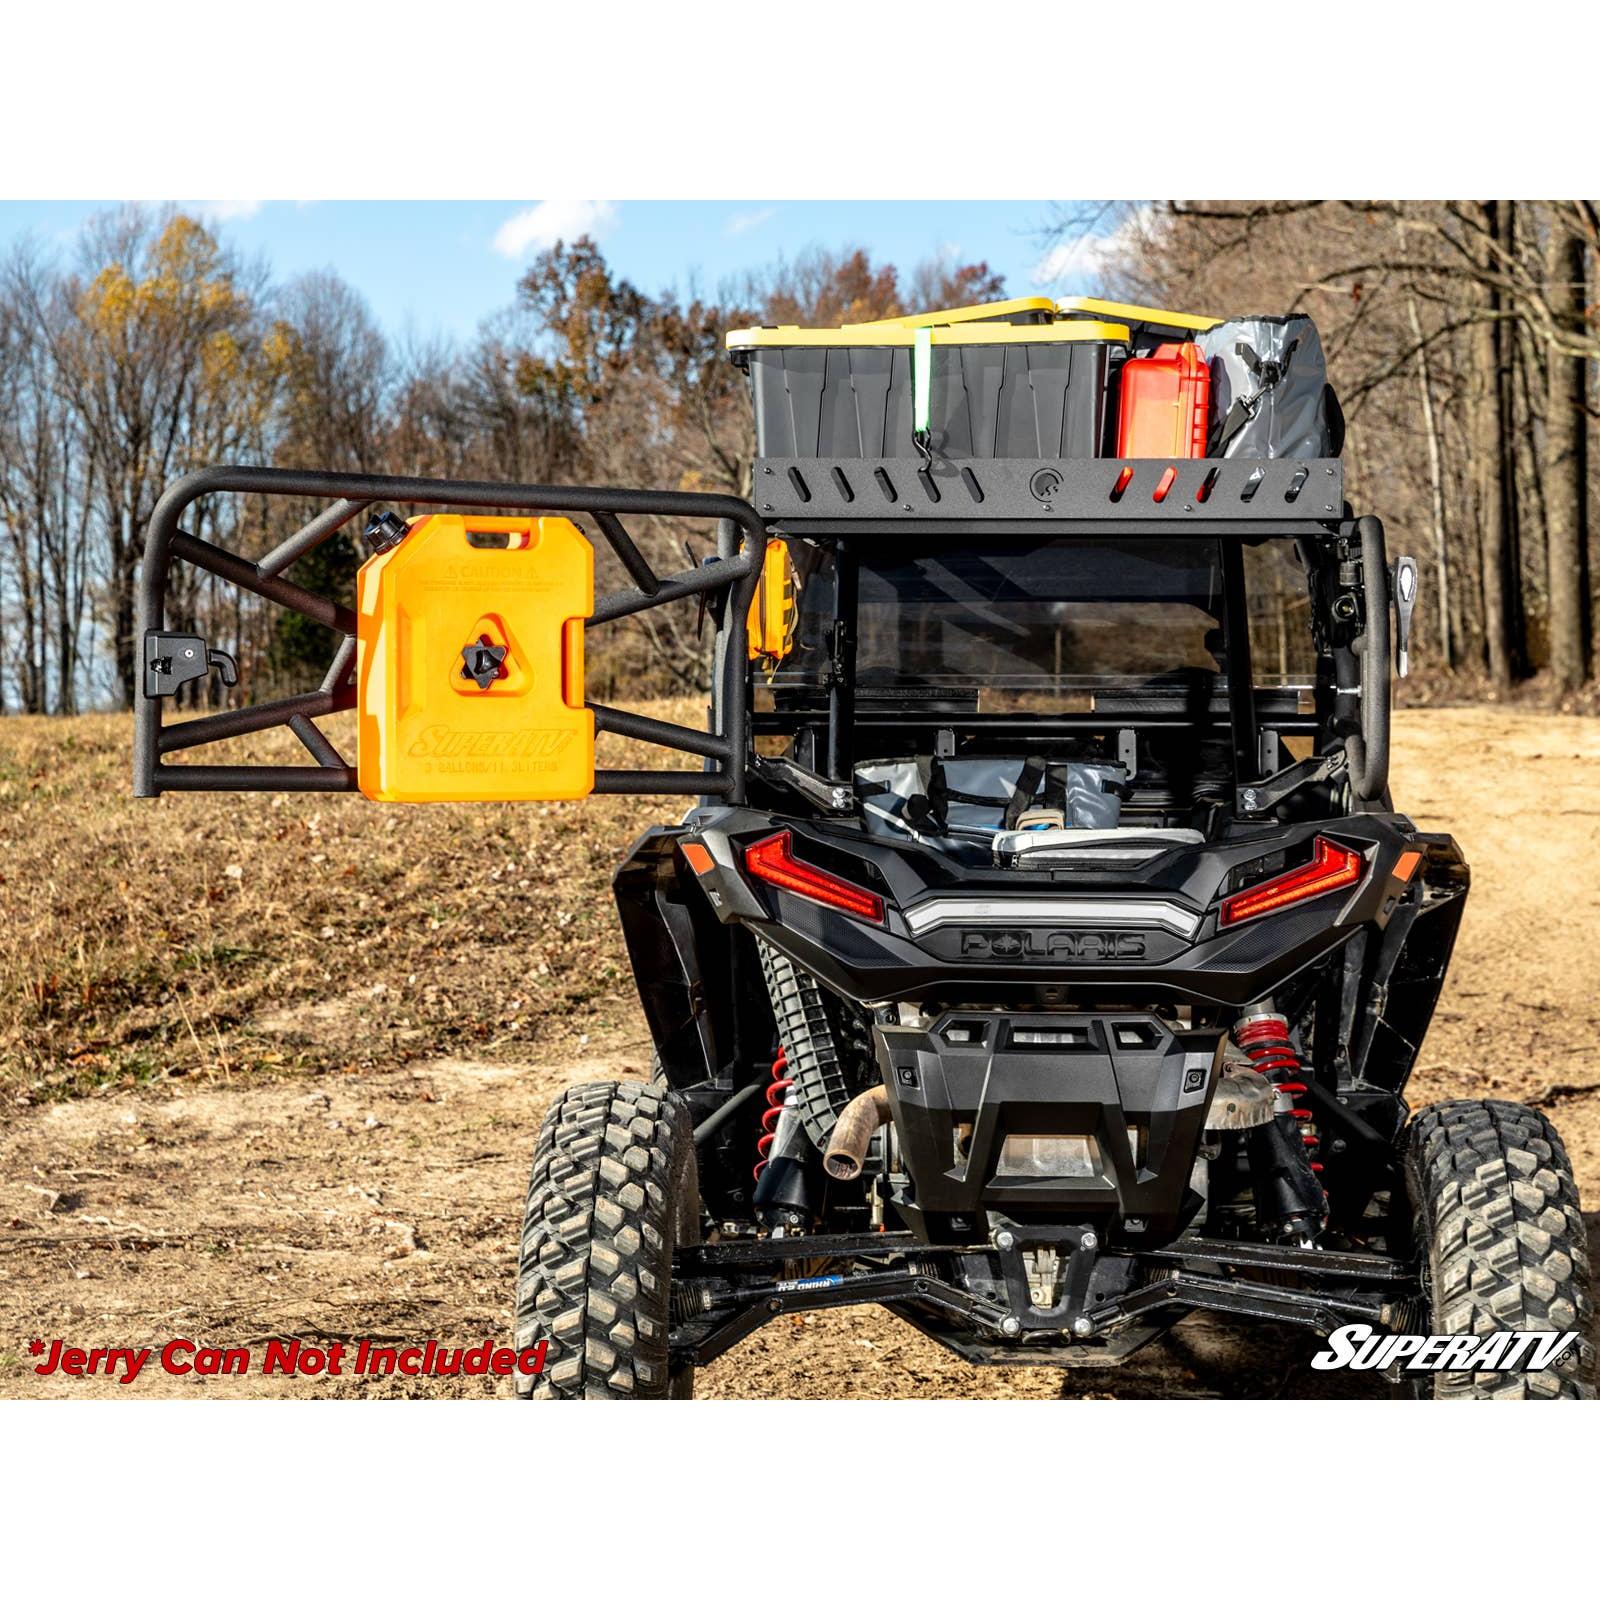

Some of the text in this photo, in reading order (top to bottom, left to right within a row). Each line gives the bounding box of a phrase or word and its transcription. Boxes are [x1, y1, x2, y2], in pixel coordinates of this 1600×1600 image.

[461, 565, 522, 578] CAUTION
[960, 931, 1146, 959] POLARIS
[797, 1280, 831, 1291] RHINO
